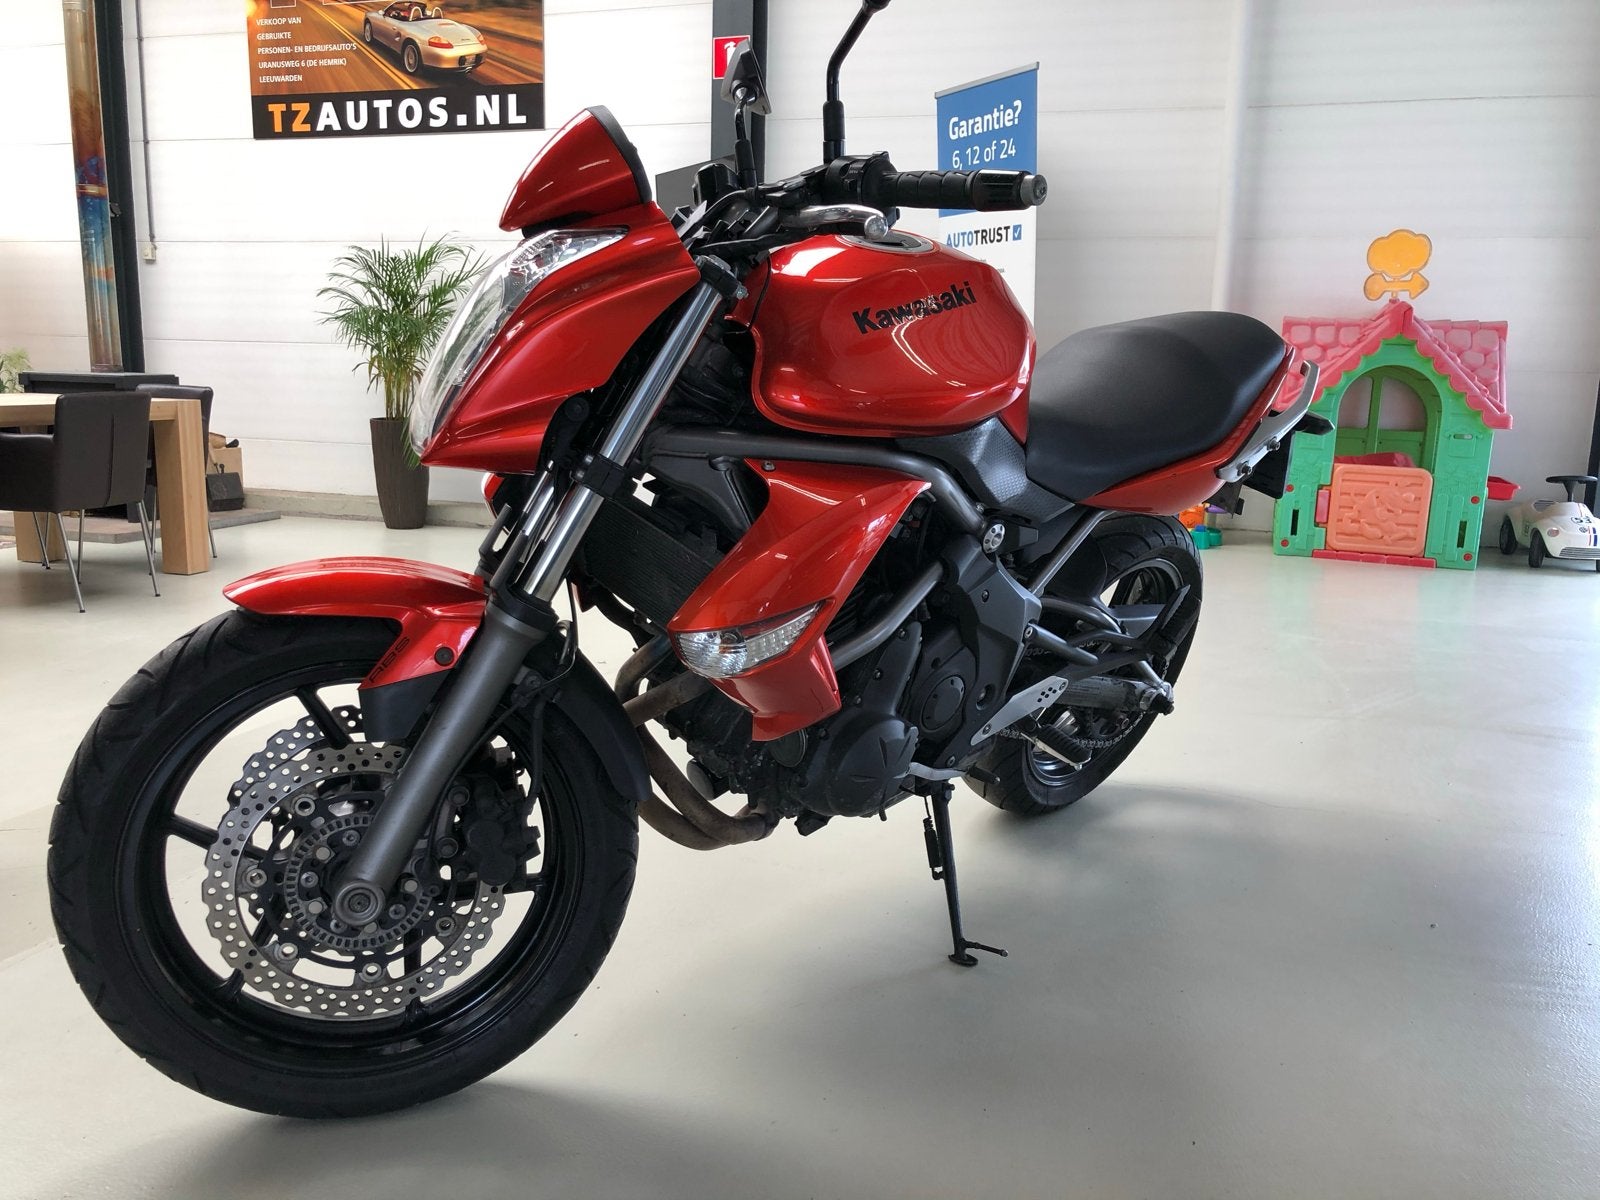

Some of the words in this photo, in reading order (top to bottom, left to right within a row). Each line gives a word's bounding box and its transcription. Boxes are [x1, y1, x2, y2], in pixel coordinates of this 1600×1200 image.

[256, 17, 287, 26] VERKOOP
[288, 17, 302, 25] VAN
[256, 32, 292, 40] GEBRUIKTE
[257, 46, 293, 54] PERSONEN-
[258, 60, 300, 69] URANUSWEG
[306, 60, 317, 68] (DE
[318, 58, 347, 67] HEMRIK)
[259, 74, 303, 83] LEEUWARDEN
[267, 93, 527, 133] TZAUTOS.NL
[948, 99, 1023, 141] Garantie?
[952, 150, 963, 171] 6,
[965, 145, 981, 166] 12
[983, 140, 997, 162] of
[999, 138, 1017, 160] 24
[946, 225, 1011, 248] AUTOTRUST
[851, 281, 977, 335] Kawasaki
